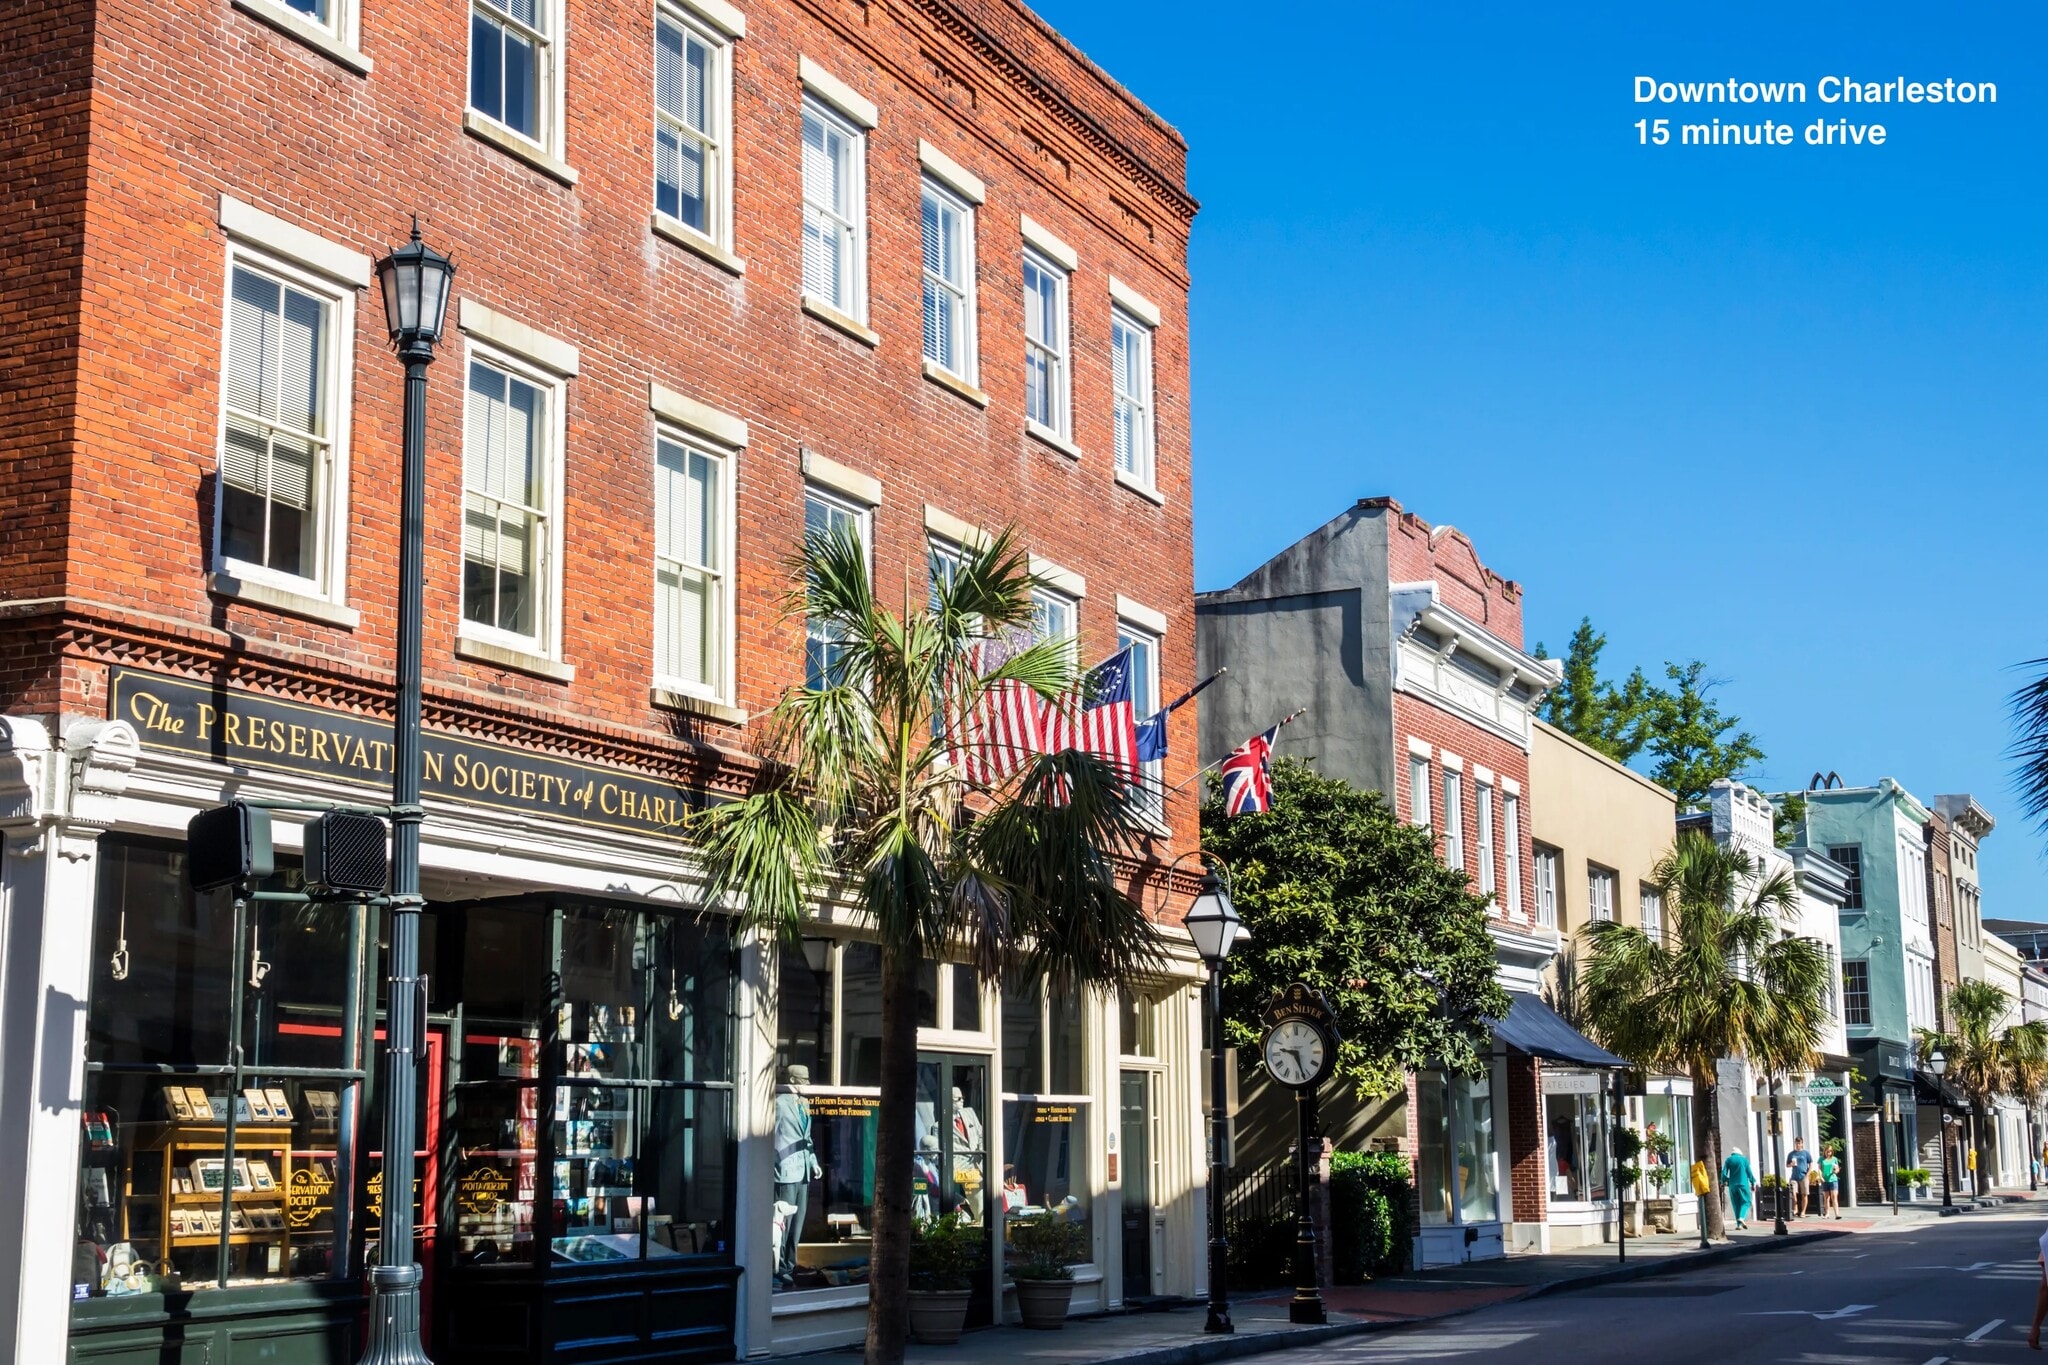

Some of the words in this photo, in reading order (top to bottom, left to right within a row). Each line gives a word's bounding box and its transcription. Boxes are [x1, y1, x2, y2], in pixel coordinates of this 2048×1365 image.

[130, 692, 185, 734] The
[196, 703, 444, 783] PRESERVATIN
[453, 753, 572, 806] SOCIETY
[573, 780, 594, 810] of
[1273, 1005, 1292, 1020] BEN
[1292, 1002, 1323, 1020] SILVER
[1545, 1081, 1586, 1089] ATELIER
[289, 1196, 318, 1206] OCIETY
